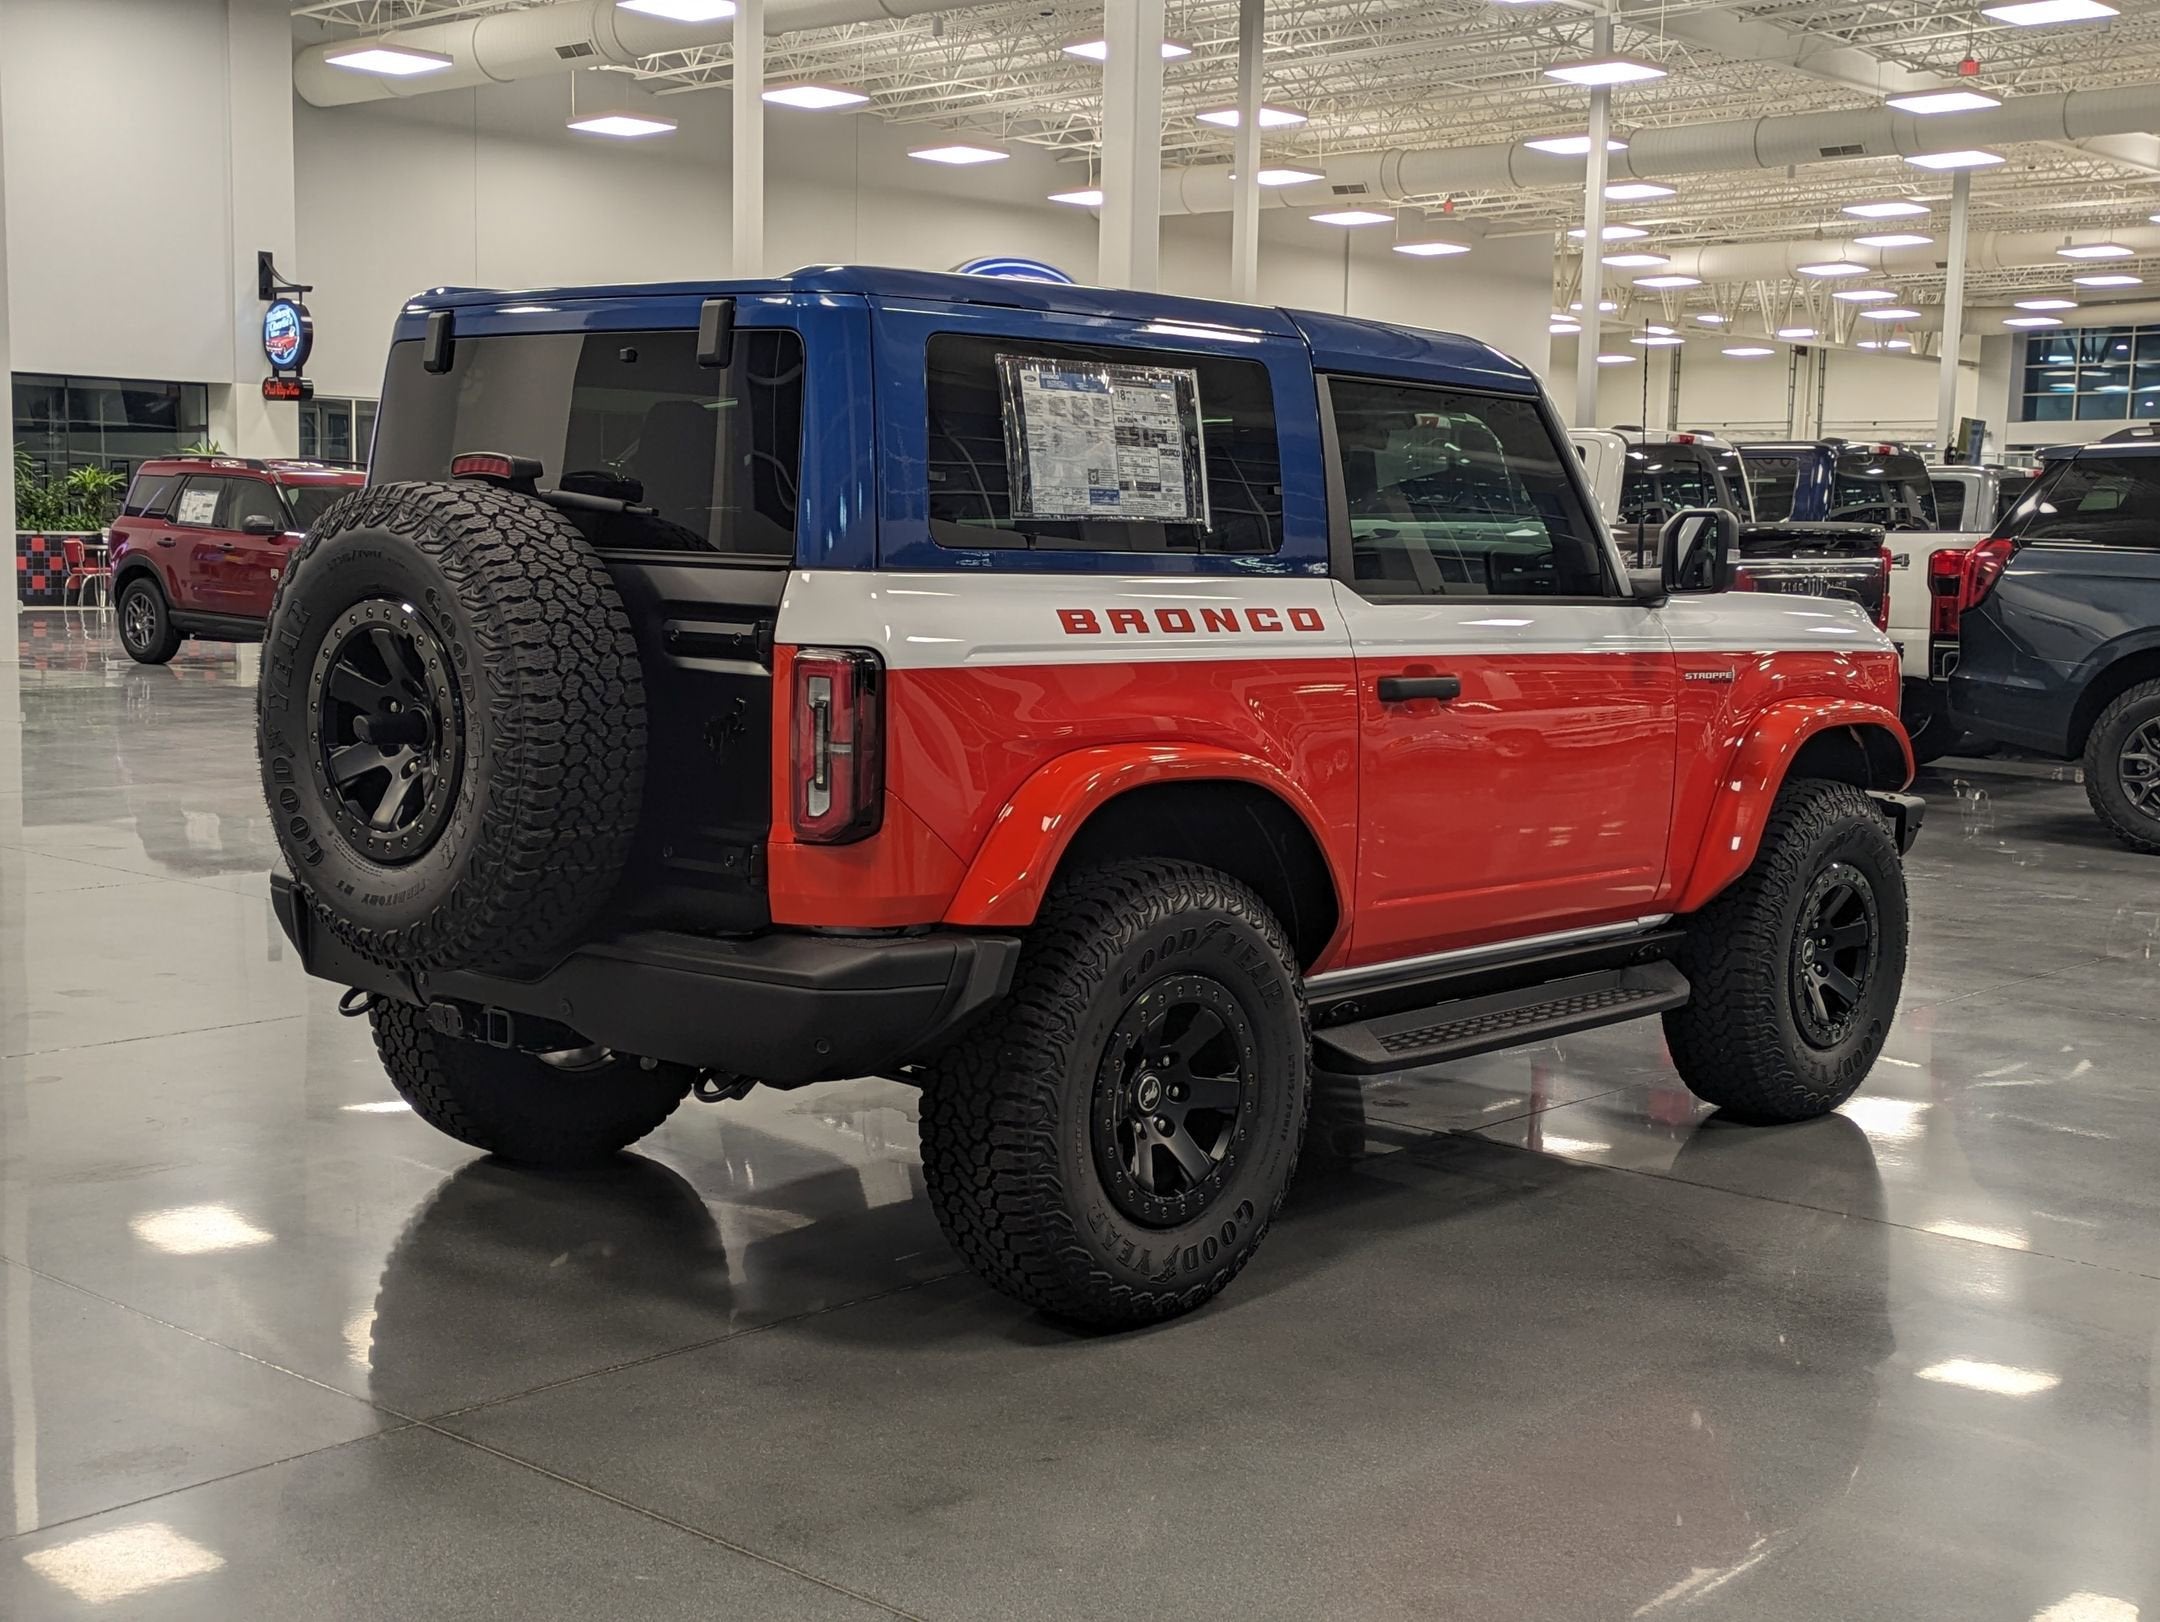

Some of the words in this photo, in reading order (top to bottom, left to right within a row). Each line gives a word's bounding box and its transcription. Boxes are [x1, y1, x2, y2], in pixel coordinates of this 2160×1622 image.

[1056, 608, 1326, 634] BRONCO
[1685, 672, 1733, 681] STROPPE
[262, 598, 325, 867] GOODYEAR
[1119, 920, 1285, 1009] GOODYEAR
[1087, 1198, 1255, 1285] GOODYEAR
